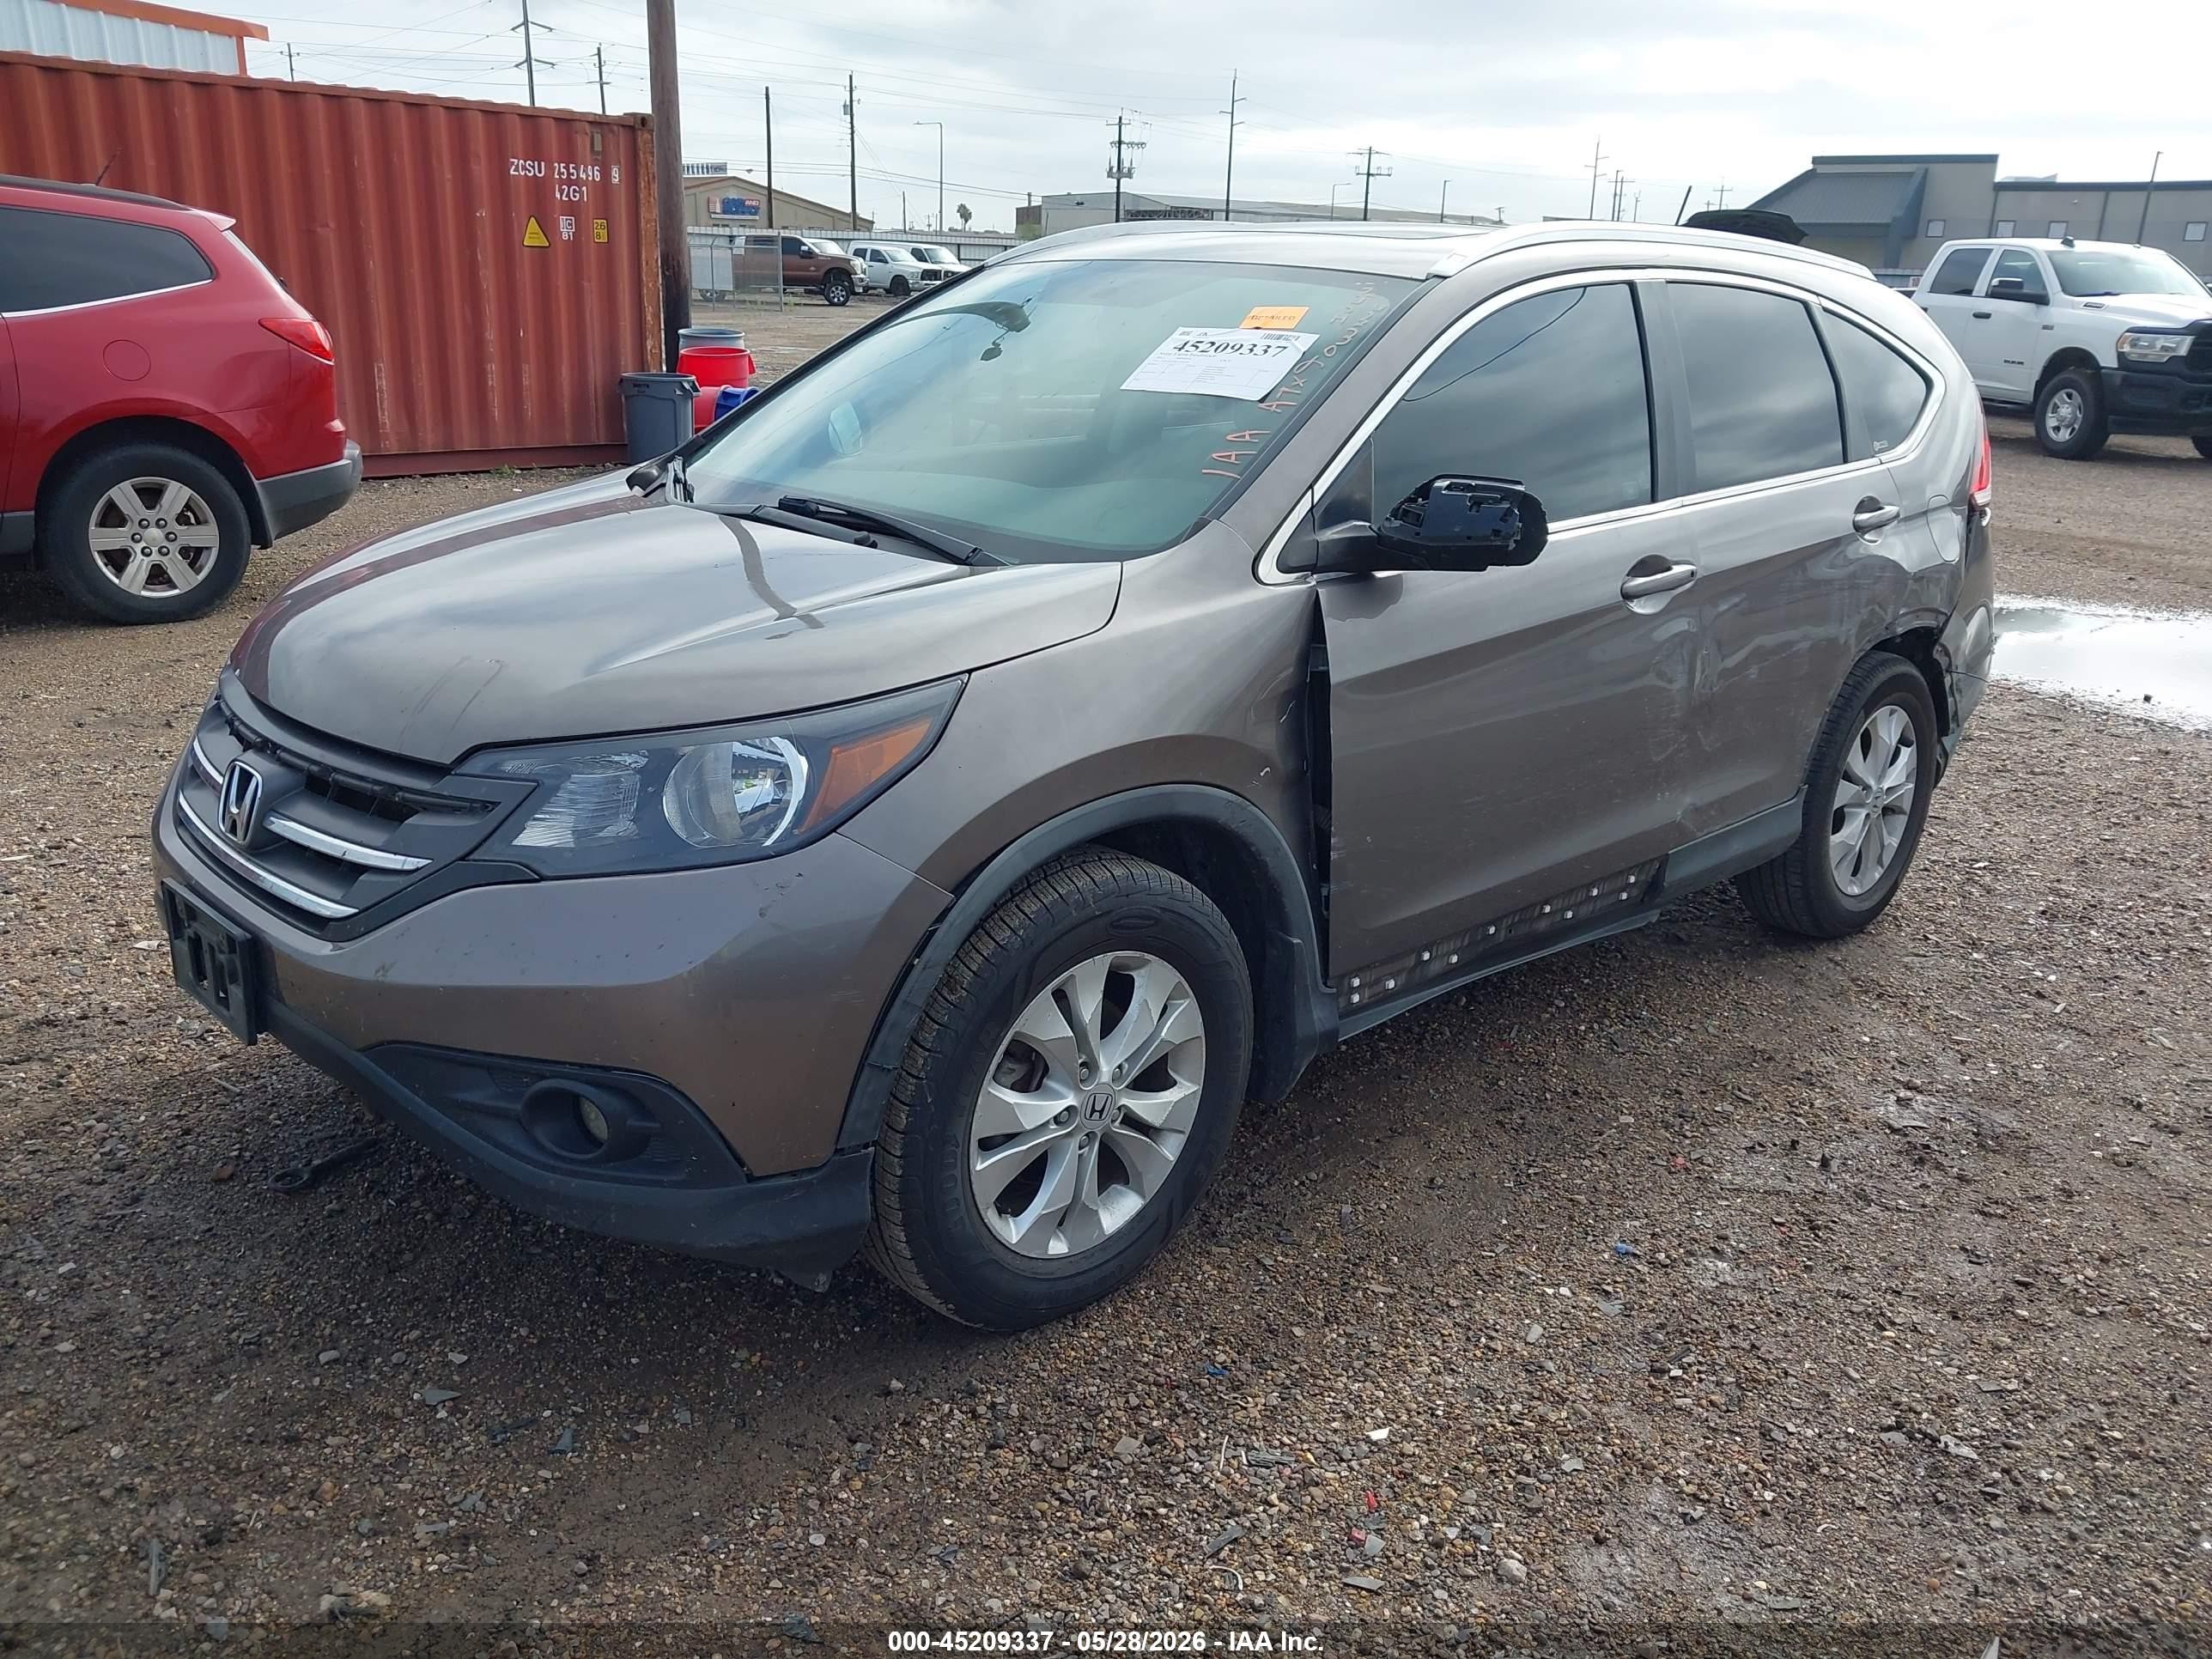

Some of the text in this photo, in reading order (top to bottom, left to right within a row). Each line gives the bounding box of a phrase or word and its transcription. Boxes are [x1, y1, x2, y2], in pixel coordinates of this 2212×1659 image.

[508, 158, 620, 184] ZCSU 255496 9
[555, 184, 587, 203] 42G1
[594, 222, 606, 230] 26
[562, 232, 574, 241] 81
[1172, 338, 1290, 359] 45209337
[1201, 429, 1271, 479] IAA
